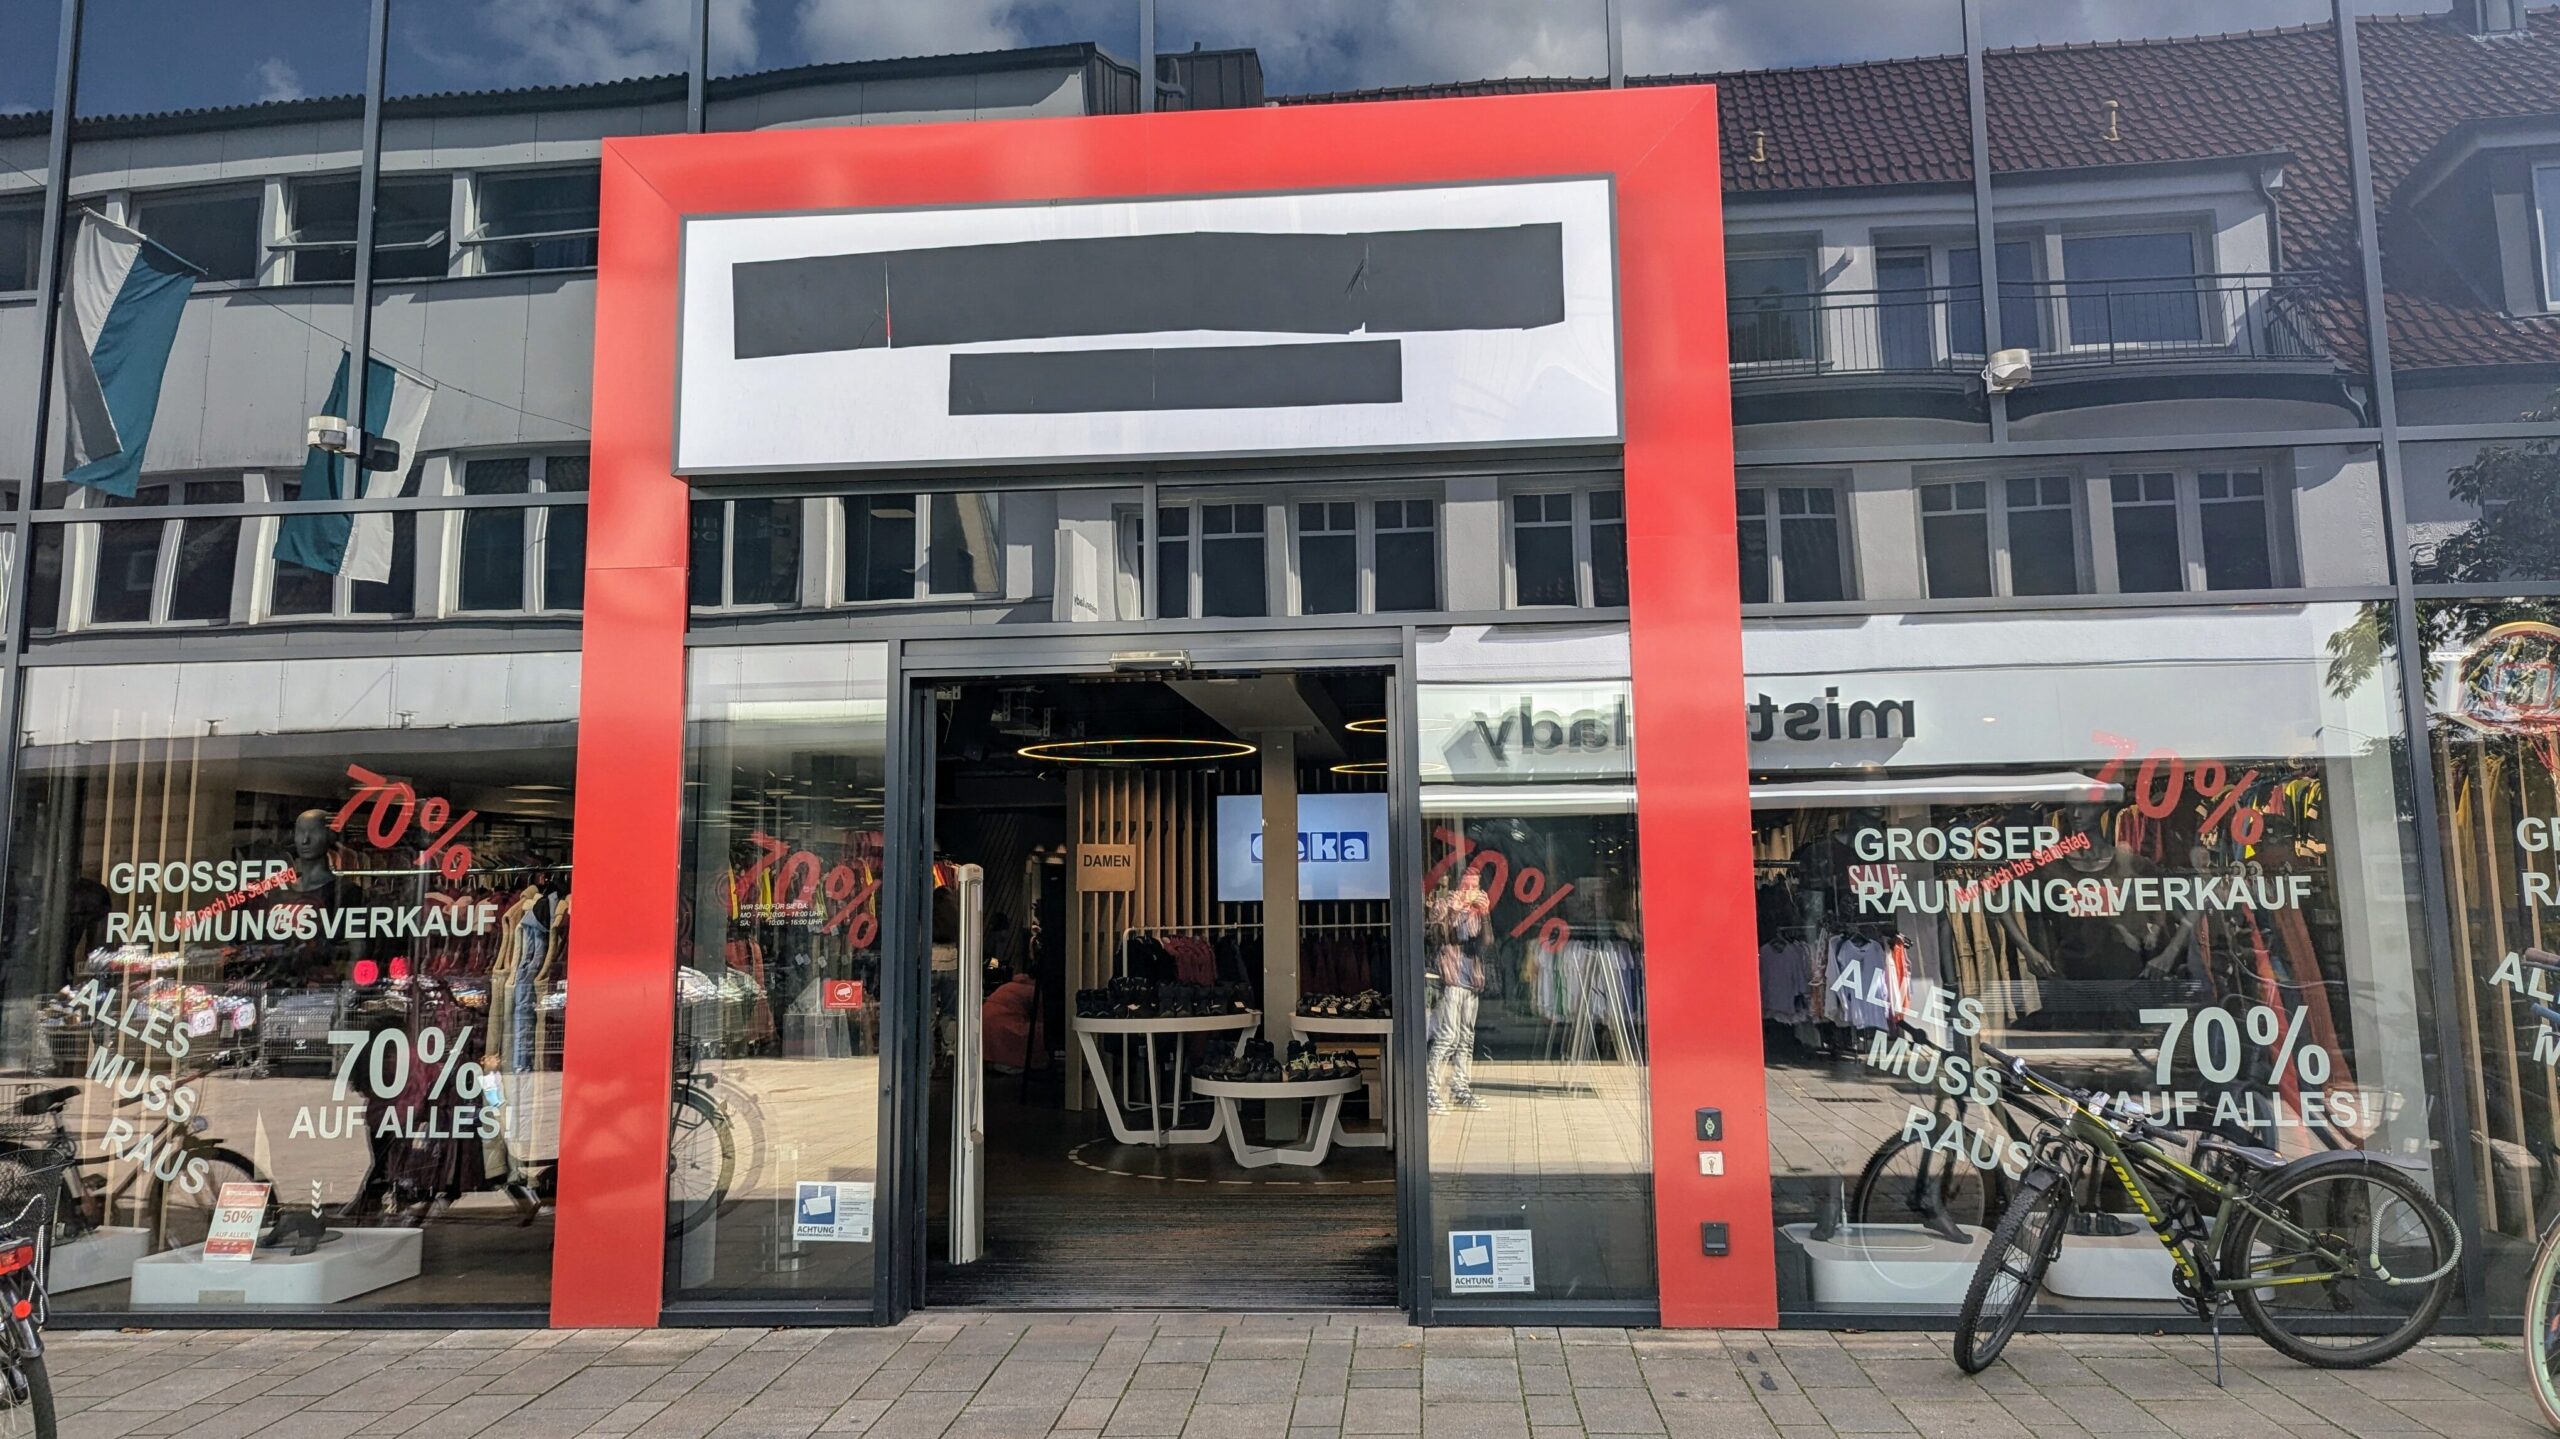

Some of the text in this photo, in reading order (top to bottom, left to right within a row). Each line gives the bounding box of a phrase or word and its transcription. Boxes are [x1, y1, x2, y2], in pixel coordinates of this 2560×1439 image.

[329, 763, 478, 880] 70%
[2088, 729, 2264, 845] 70%
[109, 859, 289, 894] GROSSER
[1083, 854, 1131, 868] DAMEN
[1854, 826, 2063, 861] GROSSER
[1954, 831, 2091, 905] Nur noch bis Samstag
[106, 904, 499, 943] RÄUMUNGSVERKAUF
[197, 897, 226, 920] noch
[225, 889, 246, 909] bis
[246, 866, 297, 898] Samstag
[728, 831, 882, 948] 70%
[1423, 825, 1576, 953] 70%
[1859, 873, 2312, 914] RÄUMUNGSVERKAUF
[69, 978, 190, 1058] ALLES
[1830, 959, 1984, 1037] ALLES
[327, 1025, 484, 1101] 70%
[1866, 1030, 2002, 1106] MUSS
[2139, 1005, 2331, 1086] 70%
[85, 1045, 196, 1123] MUSS
[2212, 1090, 2371, 1128] ALLES!
[100, 1117, 210, 1194] RAUS
[289, 1105, 513, 1140] AUF ALLES!
[1901, 1104, 2033, 1181] RAUS
[222, 1210, 253, 1223] 50%
[797, 1225, 835, 1234] ACHTUNG
[1455, 1277, 1494, 1285] ACHTUNG
